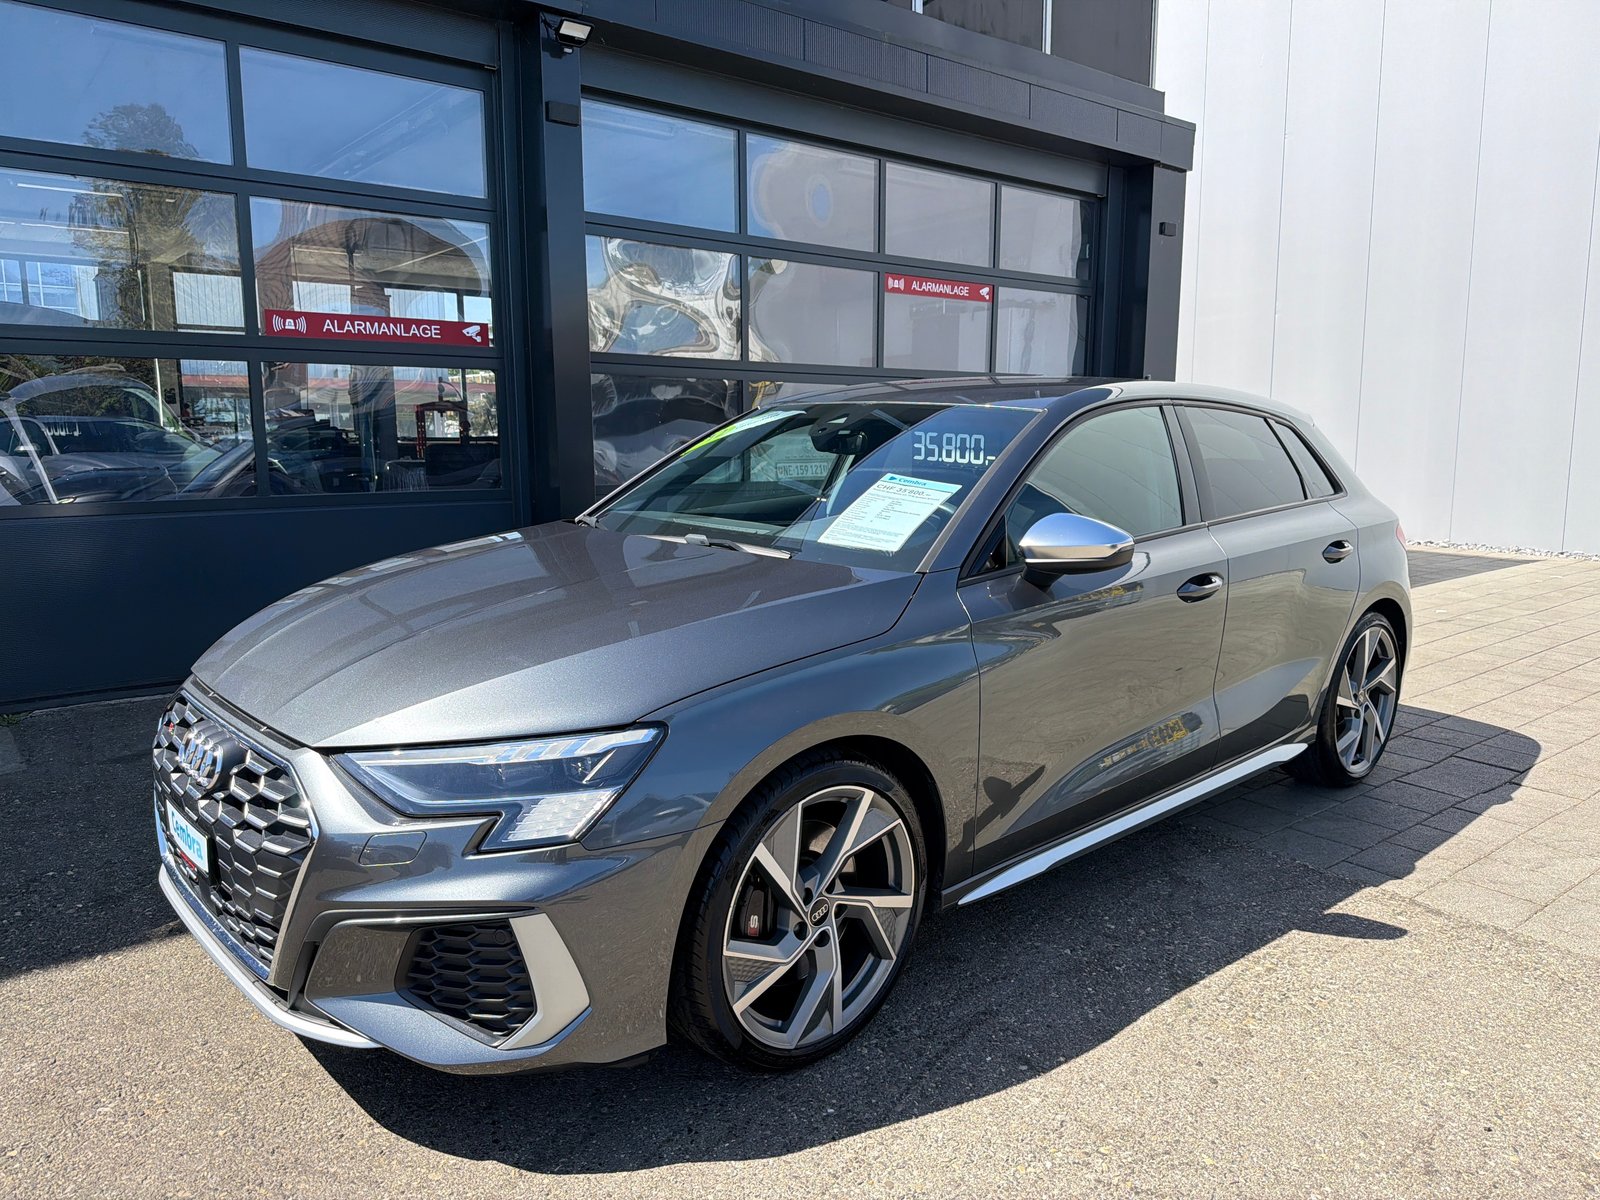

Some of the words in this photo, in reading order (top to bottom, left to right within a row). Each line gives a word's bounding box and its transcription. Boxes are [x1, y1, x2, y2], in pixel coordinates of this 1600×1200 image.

[911, 280, 970, 297] ALARMANLAGE
[323, 319, 442, 339] ALARMANLAGE
[172, 810, 204, 861] Cembra
